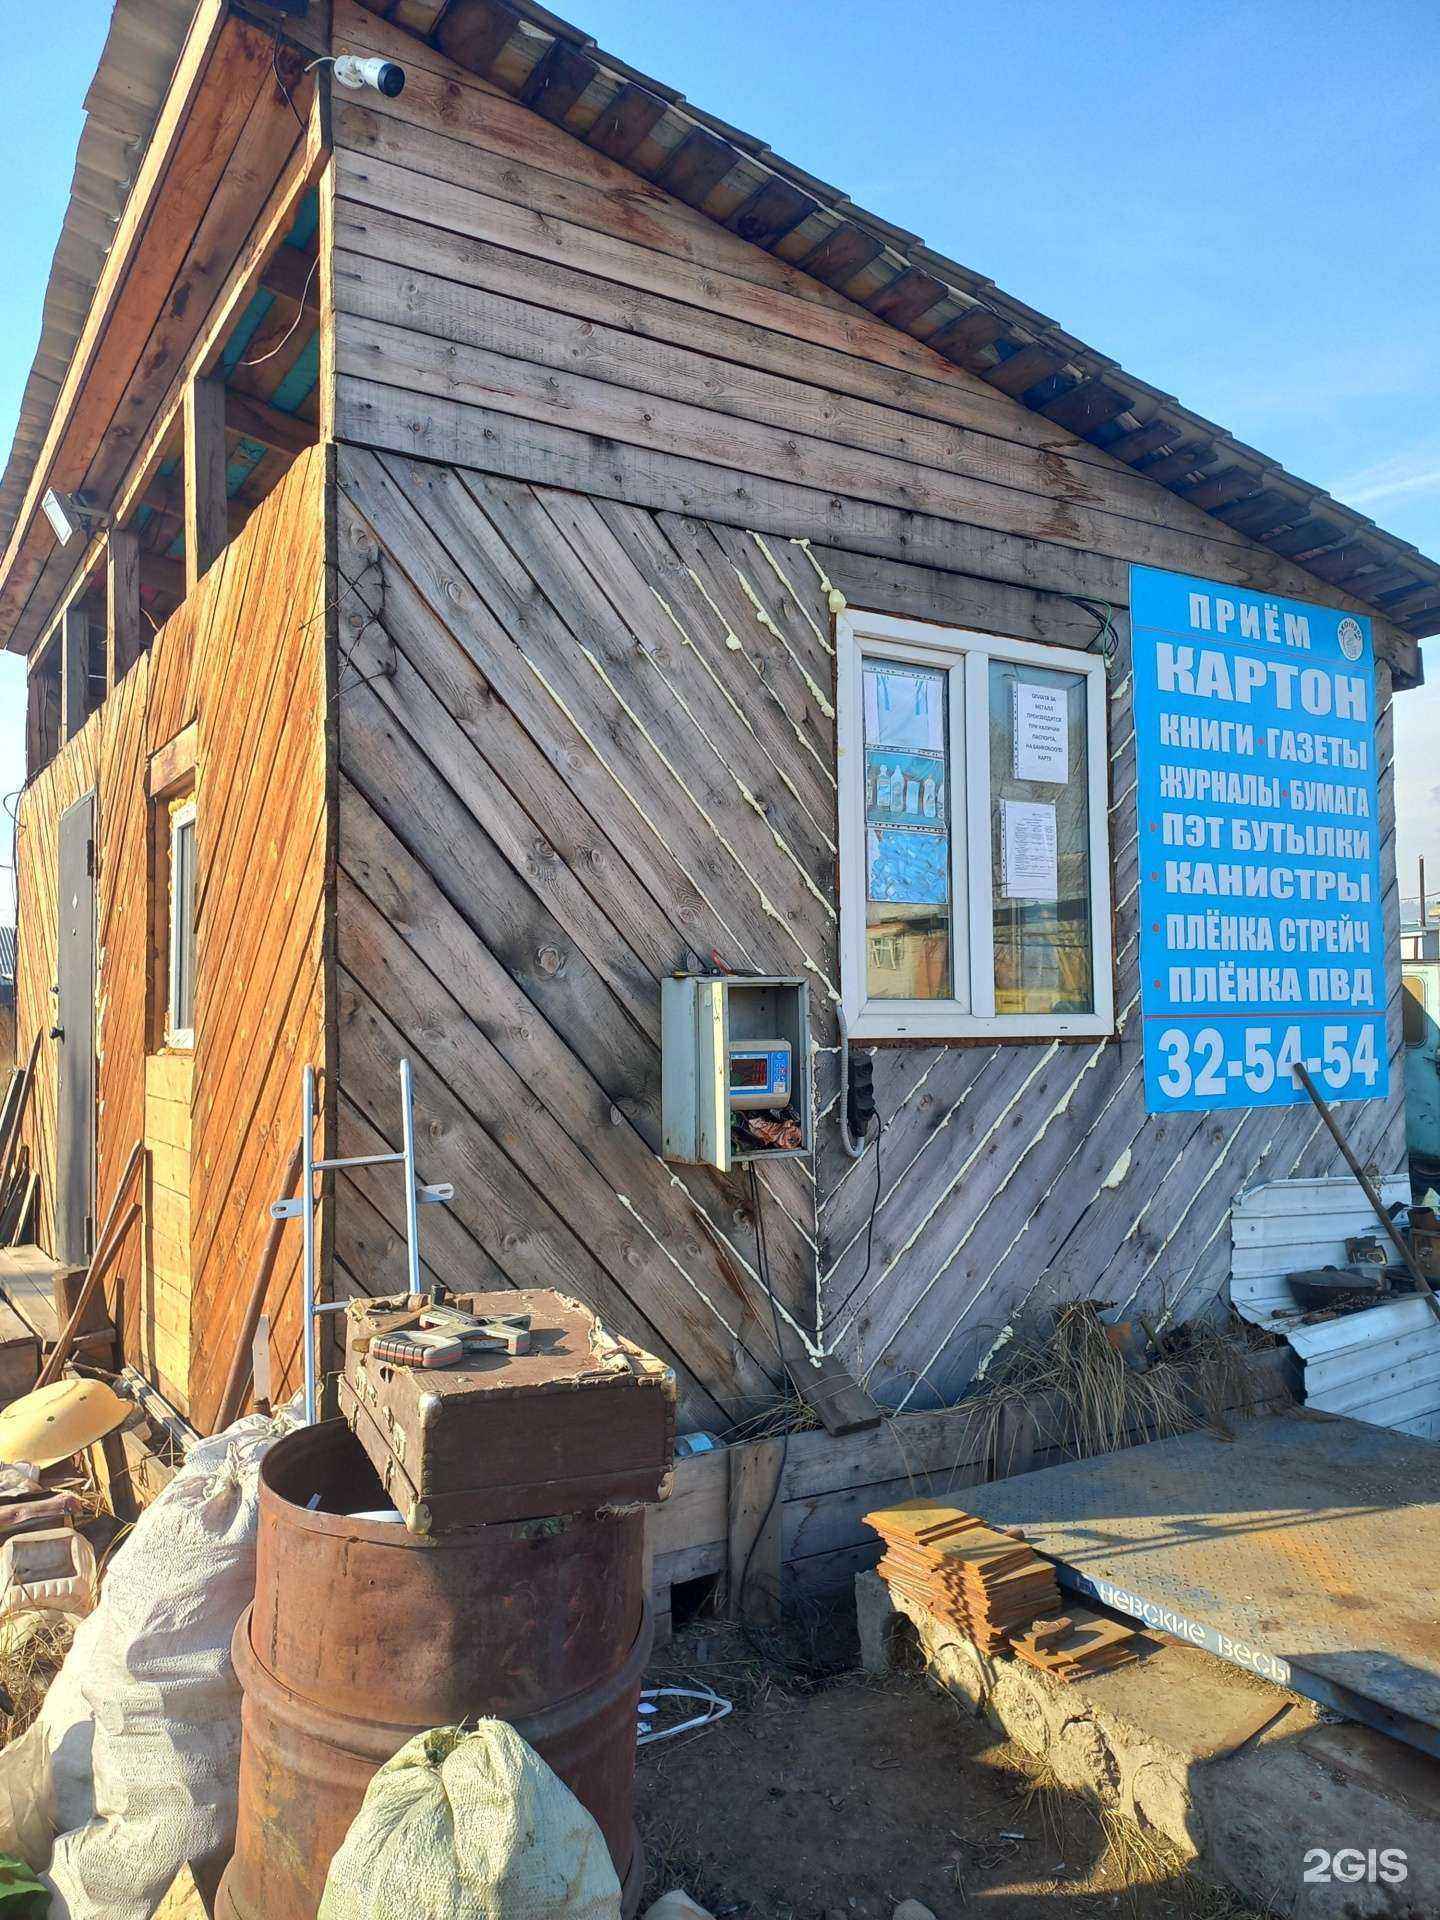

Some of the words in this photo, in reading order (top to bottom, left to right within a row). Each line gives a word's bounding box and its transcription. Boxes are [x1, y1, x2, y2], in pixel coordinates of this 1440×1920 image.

[1189, 592, 1312, 650] ПРИЁМ
[1156, 642, 1367, 721] КАРТОН
[1160, 714, 1255, 756] КНИГИ
[1267, 727, 1368, 770] ГАЗЕТЫ
[1160, 765, 1281, 809] ЖУРНАЛЫ
[1289, 780, 1369, 817] БУМАГА
[1163, 813, 1223, 849] ПЭТ
[1231, 820, 1371, 859] БУТЫЛКИ
[1165, 861, 1371, 904] КАНИСТРЫ
[1167, 909, 1275, 953] ПЛЁНКА
[1279, 913, 1370, 954] СТРЕЙЧ
[1169, 960, 1302, 1003] ПЛЁНКА
[1309, 967, 1375, 1006] ПВД
[1157, 1022, 1379, 1098] 32-54-54
